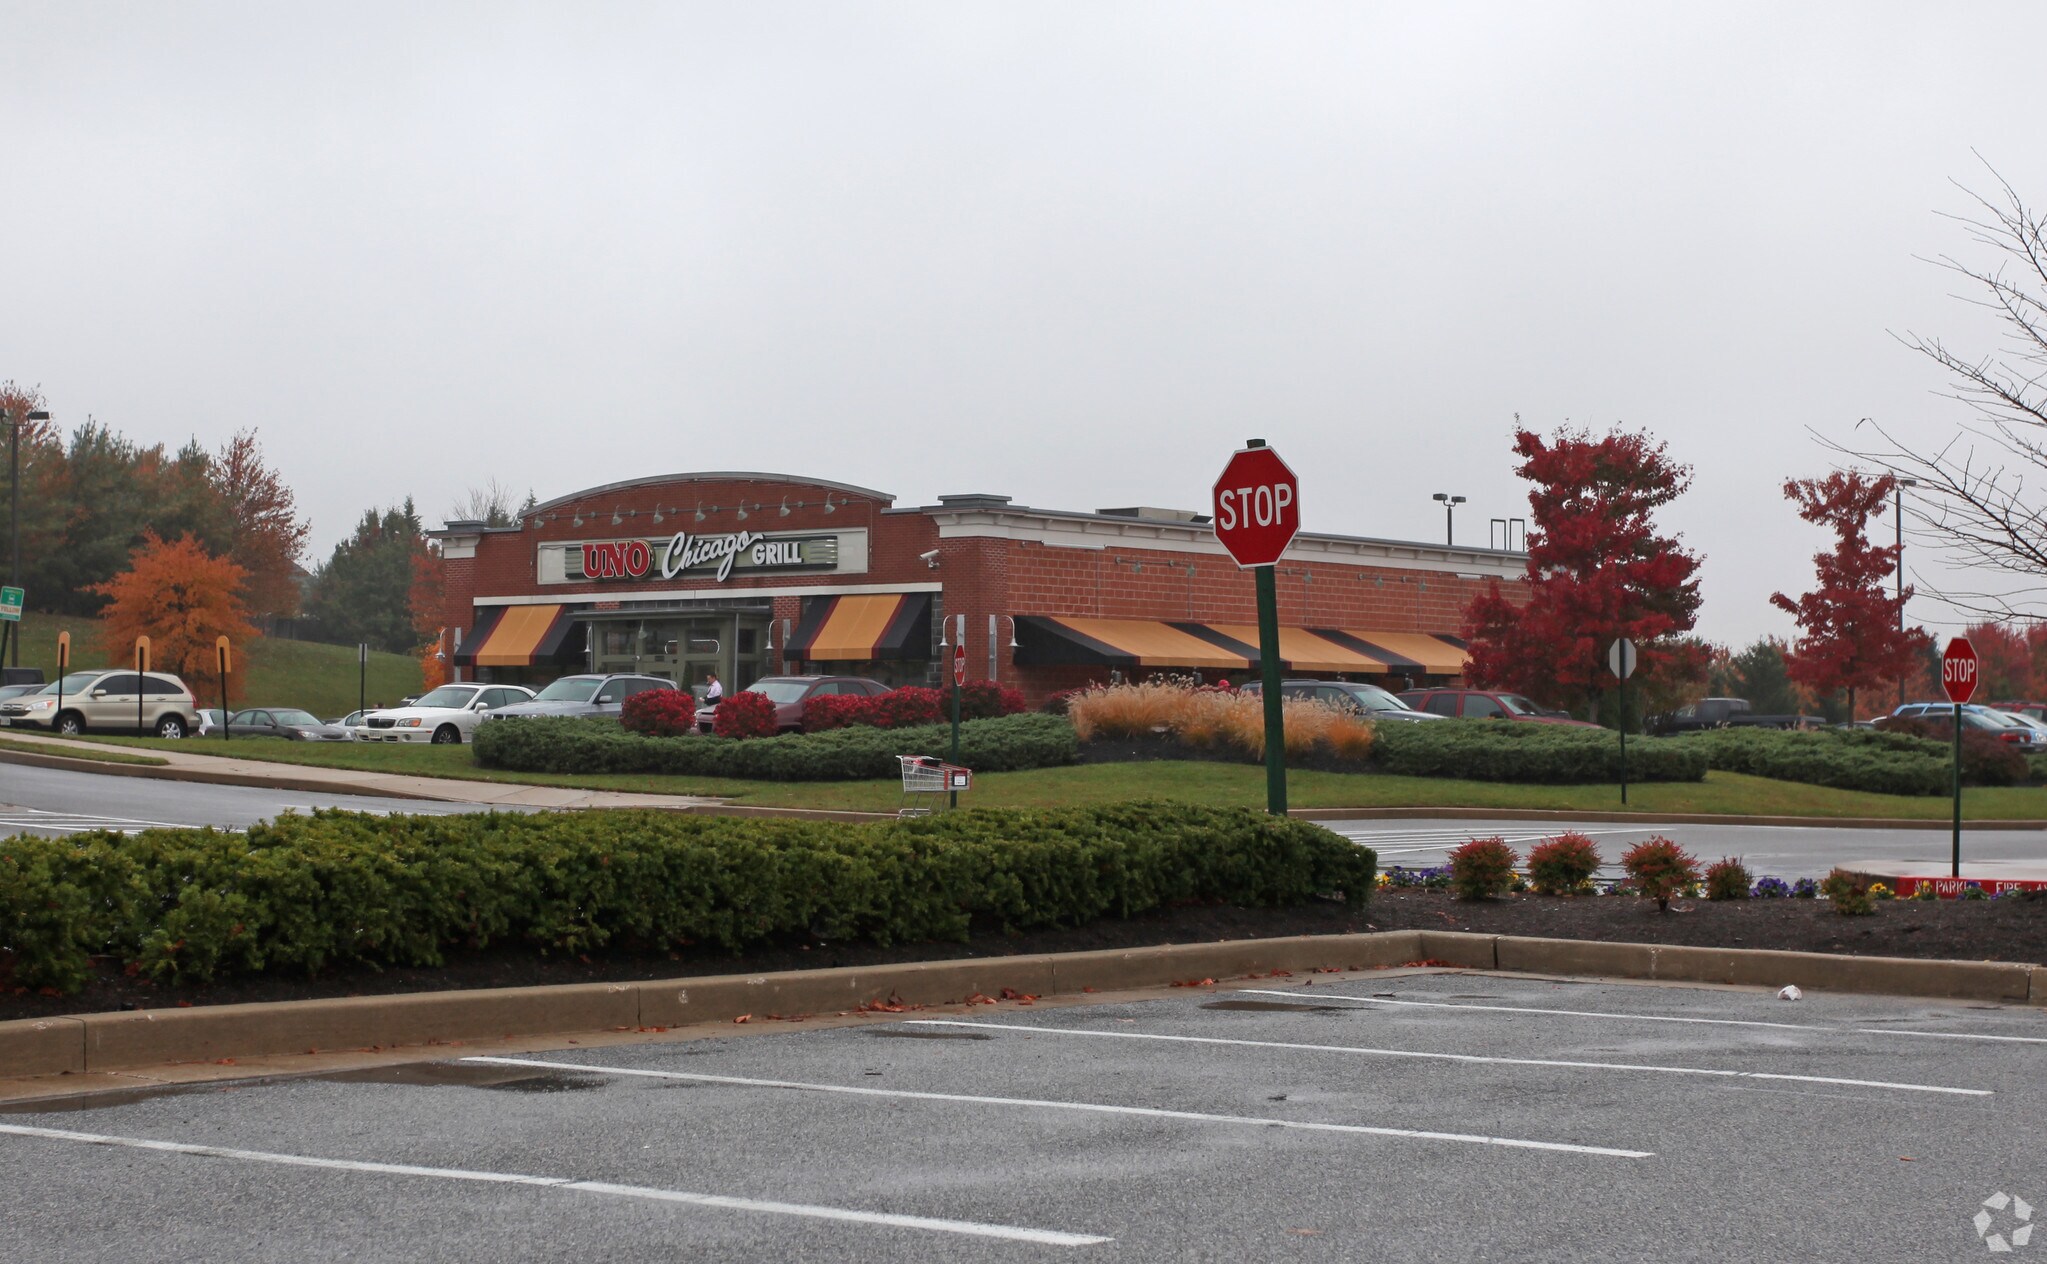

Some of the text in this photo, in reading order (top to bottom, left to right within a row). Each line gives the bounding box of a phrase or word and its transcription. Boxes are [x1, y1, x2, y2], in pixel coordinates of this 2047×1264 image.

[1220, 483, 1292, 531] STOP
[581, 530, 802, 583] UNO Chicago GRILL
[954, 657, 966, 673] STOP
[1945, 658, 1975, 682] STOP
